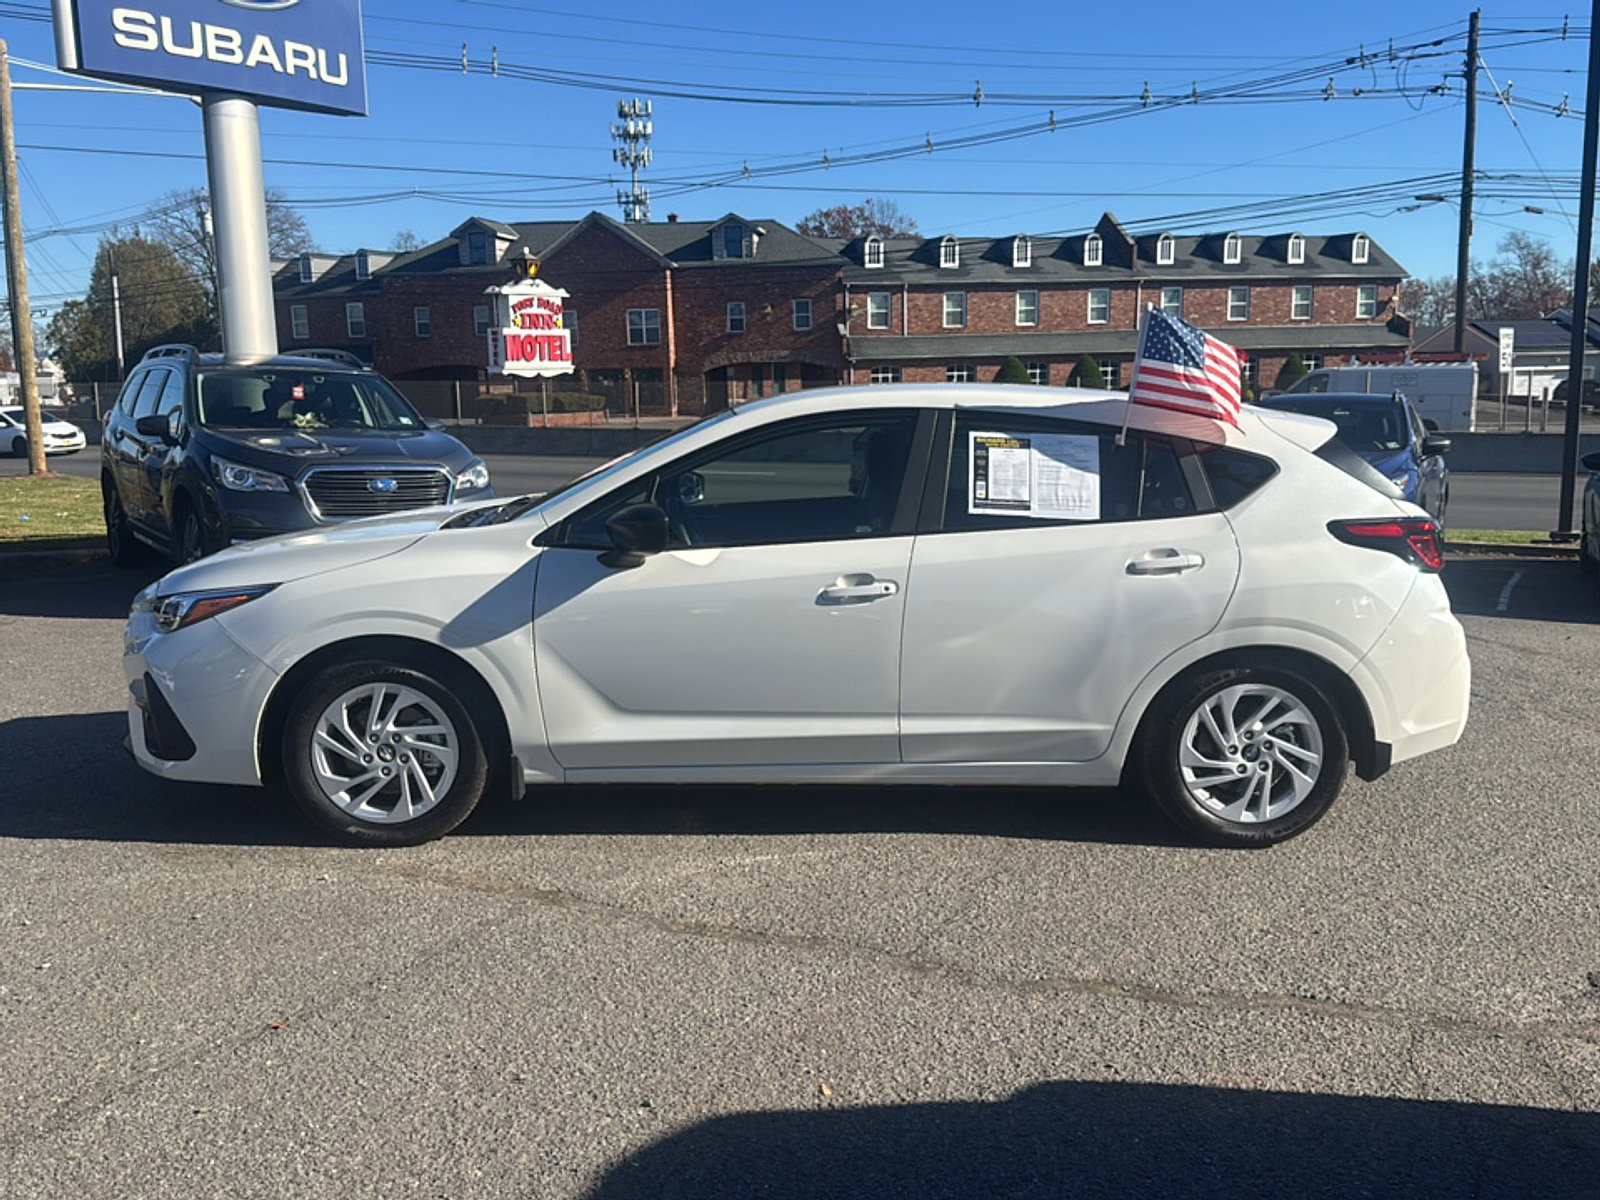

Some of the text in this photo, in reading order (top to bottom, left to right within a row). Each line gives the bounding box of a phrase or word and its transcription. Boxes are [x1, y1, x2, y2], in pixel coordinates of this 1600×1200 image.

[111, 8, 348, 86] SUBARU
[520, 313, 554, 330] INN
[505, 334, 574, 362] MOTEL
